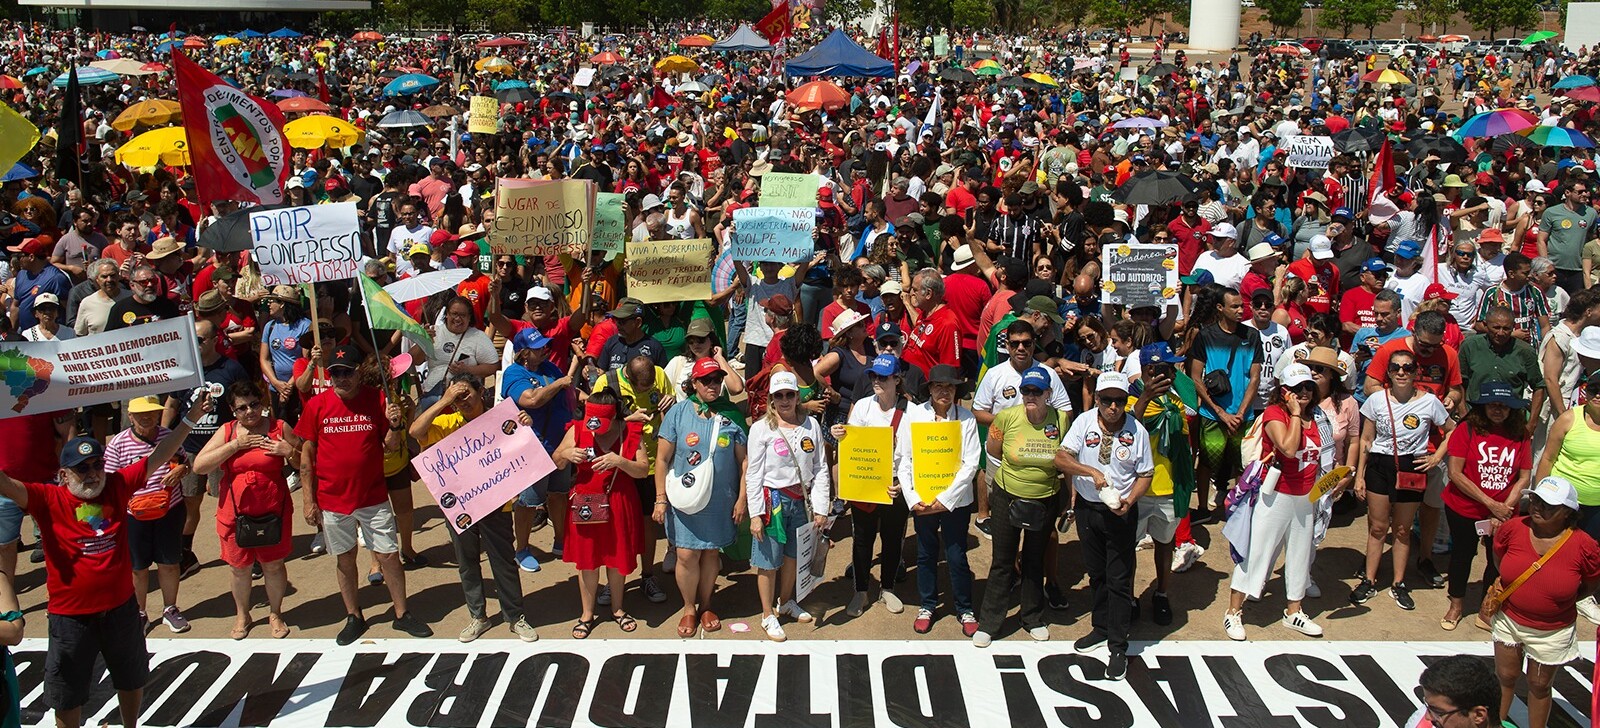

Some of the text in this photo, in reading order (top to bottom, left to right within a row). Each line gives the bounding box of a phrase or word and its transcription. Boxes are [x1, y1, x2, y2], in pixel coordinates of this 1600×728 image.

[1293, 136, 1322, 145] SEM
[1290, 144, 1333, 157] ANISTIA
[499, 197, 560, 211] LUGAR DE
[494, 209, 583, 234] CRIMINOSO
[505, 234, 518, 244] NO
[525, 229, 587, 247] PRESÍDIO
[736, 232, 781, 246] GOLPE,
[254, 230, 363, 267] CONGRESSO
[491, 243, 507, 255] NÃO
[523, 242, 585, 256] CONGRESS
[629, 246, 649, 256] VIVA
[662, 243, 708, 255] SOBERANIA
[736, 247, 777, 257] NUNCA
[480, 262, 490, 271] 19
[630, 268, 648, 278] NÃO
[652, 268, 671, 277] AOS
[262, 272, 282, 286] DA
[630, 279, 648, 288] RES
[652, 278, 662, 286] DA
[1111, 270, 1165, 283] NÃO AUTORIZO:
[57, 331, 182, 362] EM DEFESA DA DEMOCRACIA.
[63, 352, 144, 373] AINDA ESTOU AQUI.
[68, 358, 179, 385] SEM ANISTIA A GOLPISTAS.
[67, 372, 172, 397] DITADURA NUNCA MAIS.
[330, 416, 353, 424] BRASIL
[353, 413, 359, 422] É
[323, 423, 373, 434] BRASILEIROS
[422, 432, 495, 487] Golpistas
[478, 447, 502, 468] não
[1478, 441, 1516, 467] SEM
[1480, 473, 1509, 483] PARA
